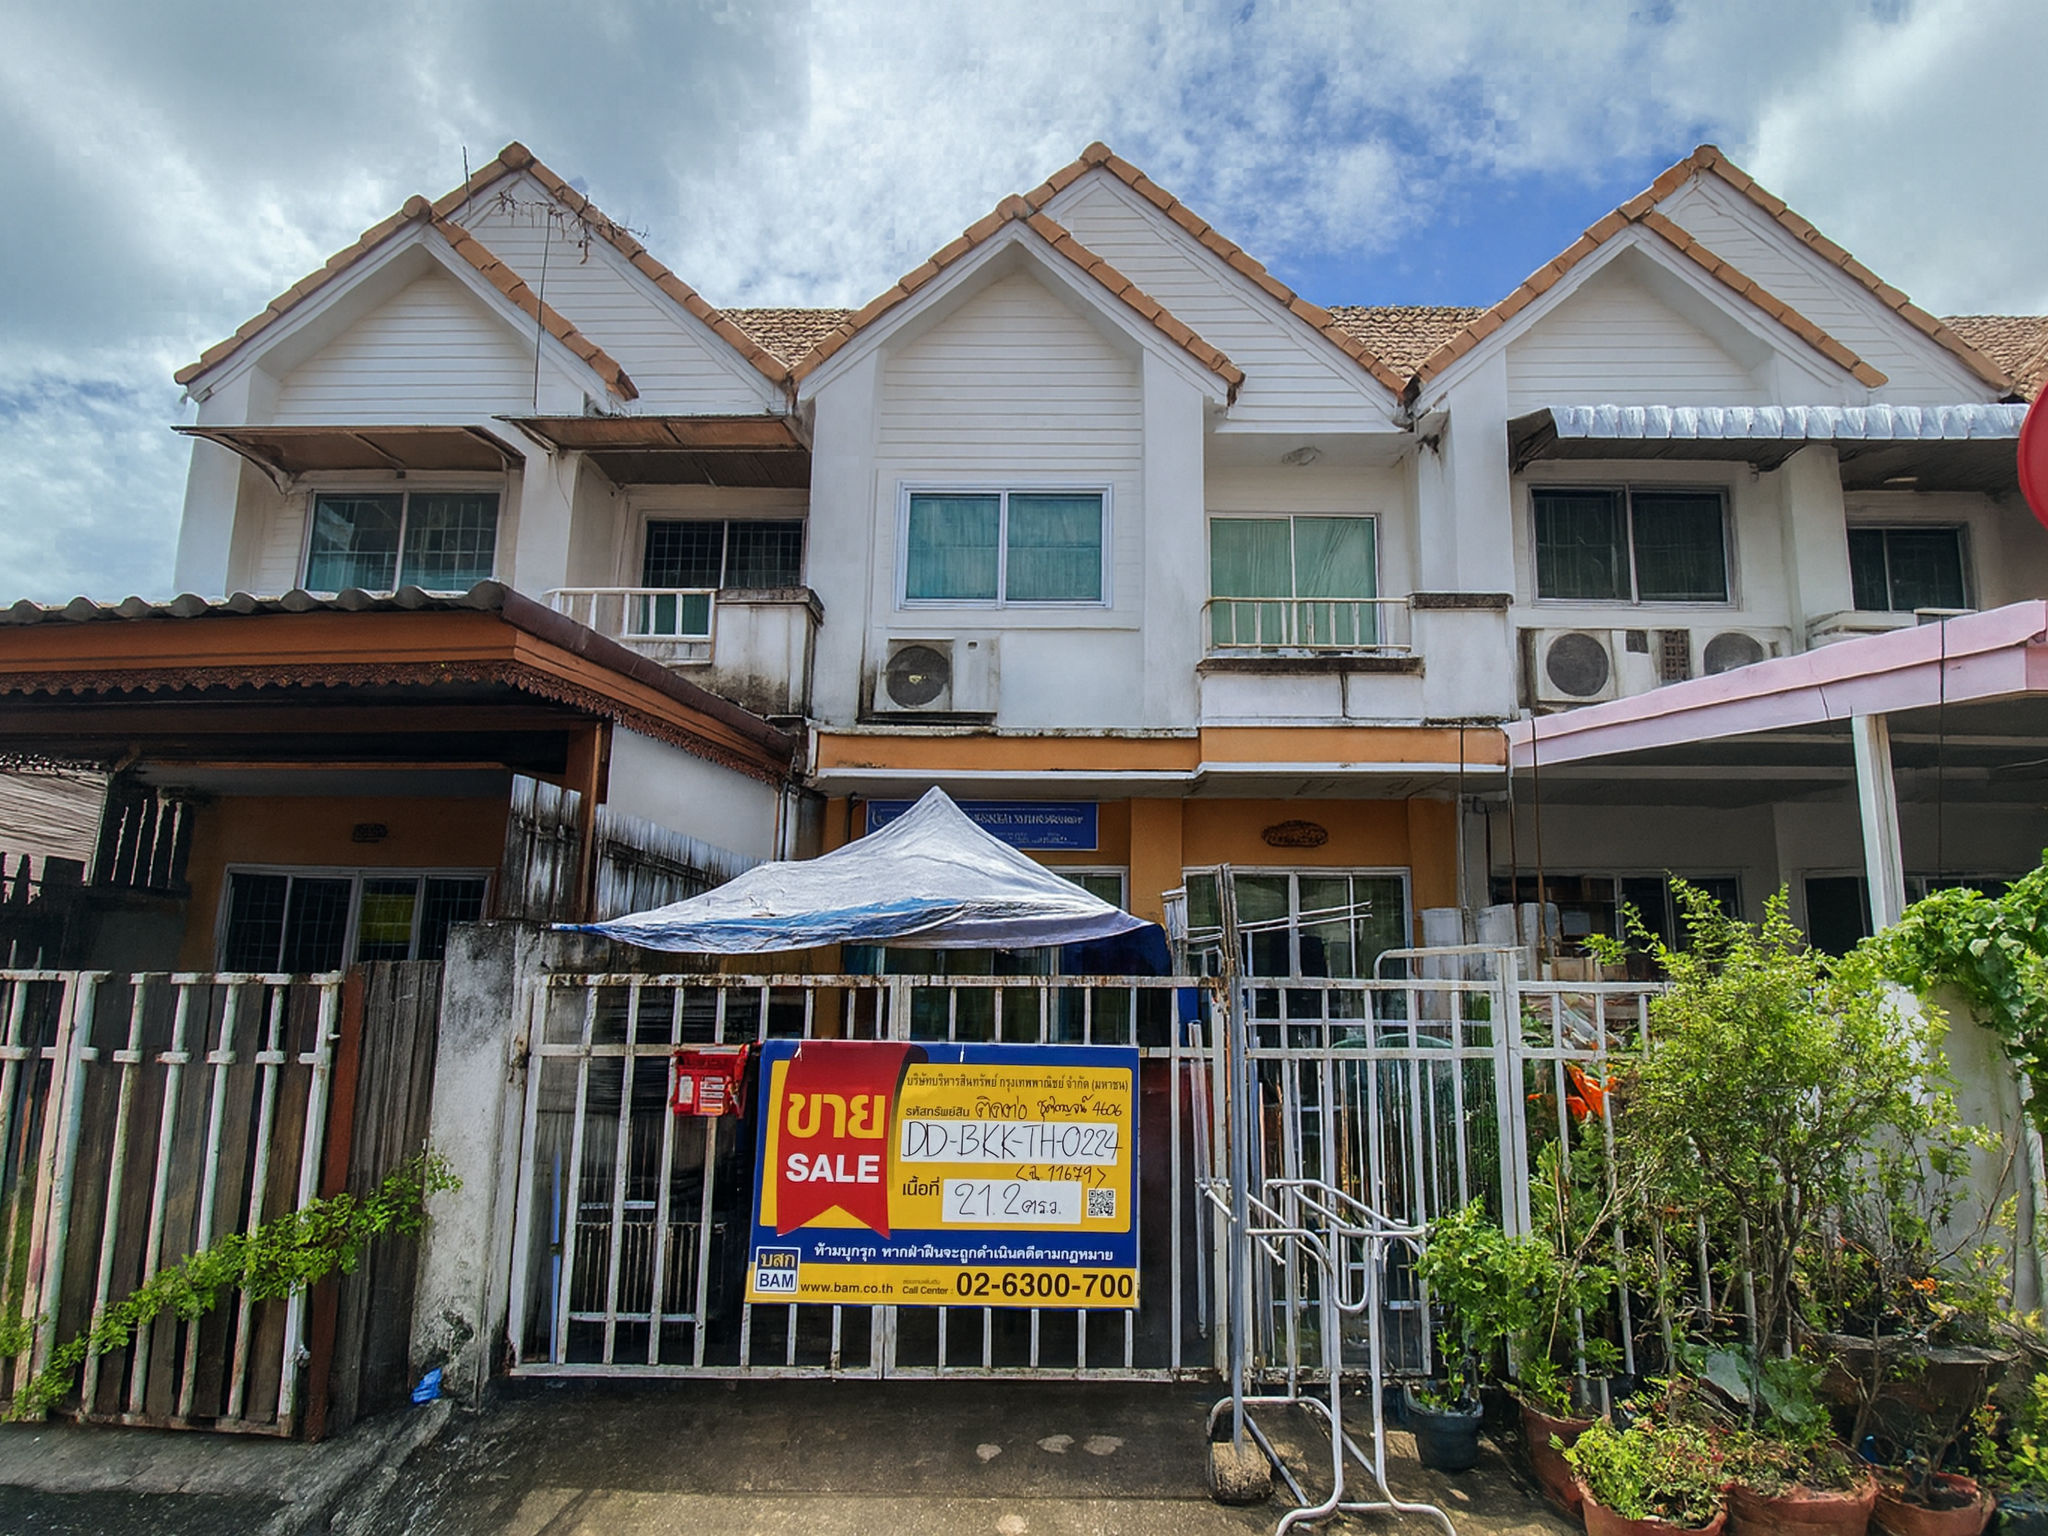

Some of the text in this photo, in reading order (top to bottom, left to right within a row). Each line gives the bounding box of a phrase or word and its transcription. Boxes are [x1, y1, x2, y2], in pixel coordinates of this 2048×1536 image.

[1066, 1075, 1090, 1089] จำกัด
[1091, 1079, 1129, 1093] (มหาชน)
[786, 1093, 886, 1139] ขาย
[905, 1105, 970, 1117] รหัสทรัพย์สิน
[975, 1095, 1028, 1120] ติดต่อ
[1092, 1101, 1122, 1116] 4606
[902, 1121, 1123, 1160] DD-BKK-TH-0224
[785, 1152, 880, 1183] SALE
[902, 1175, 940, 1196] เนื้อที่
[760, 1253, 795, 1268] บสก
[814, 1242, 876, 1262] ห้ามบุกรุก
[760, 1273, 794, 1288] BAM
[801, 1282, 893, 1294] www.bam.co.th
[902, 1285, 918, 1294] Call
[920, 1285, 948, 1295] Center
[956, 1271, 1133, 1298] 02-6300-700
